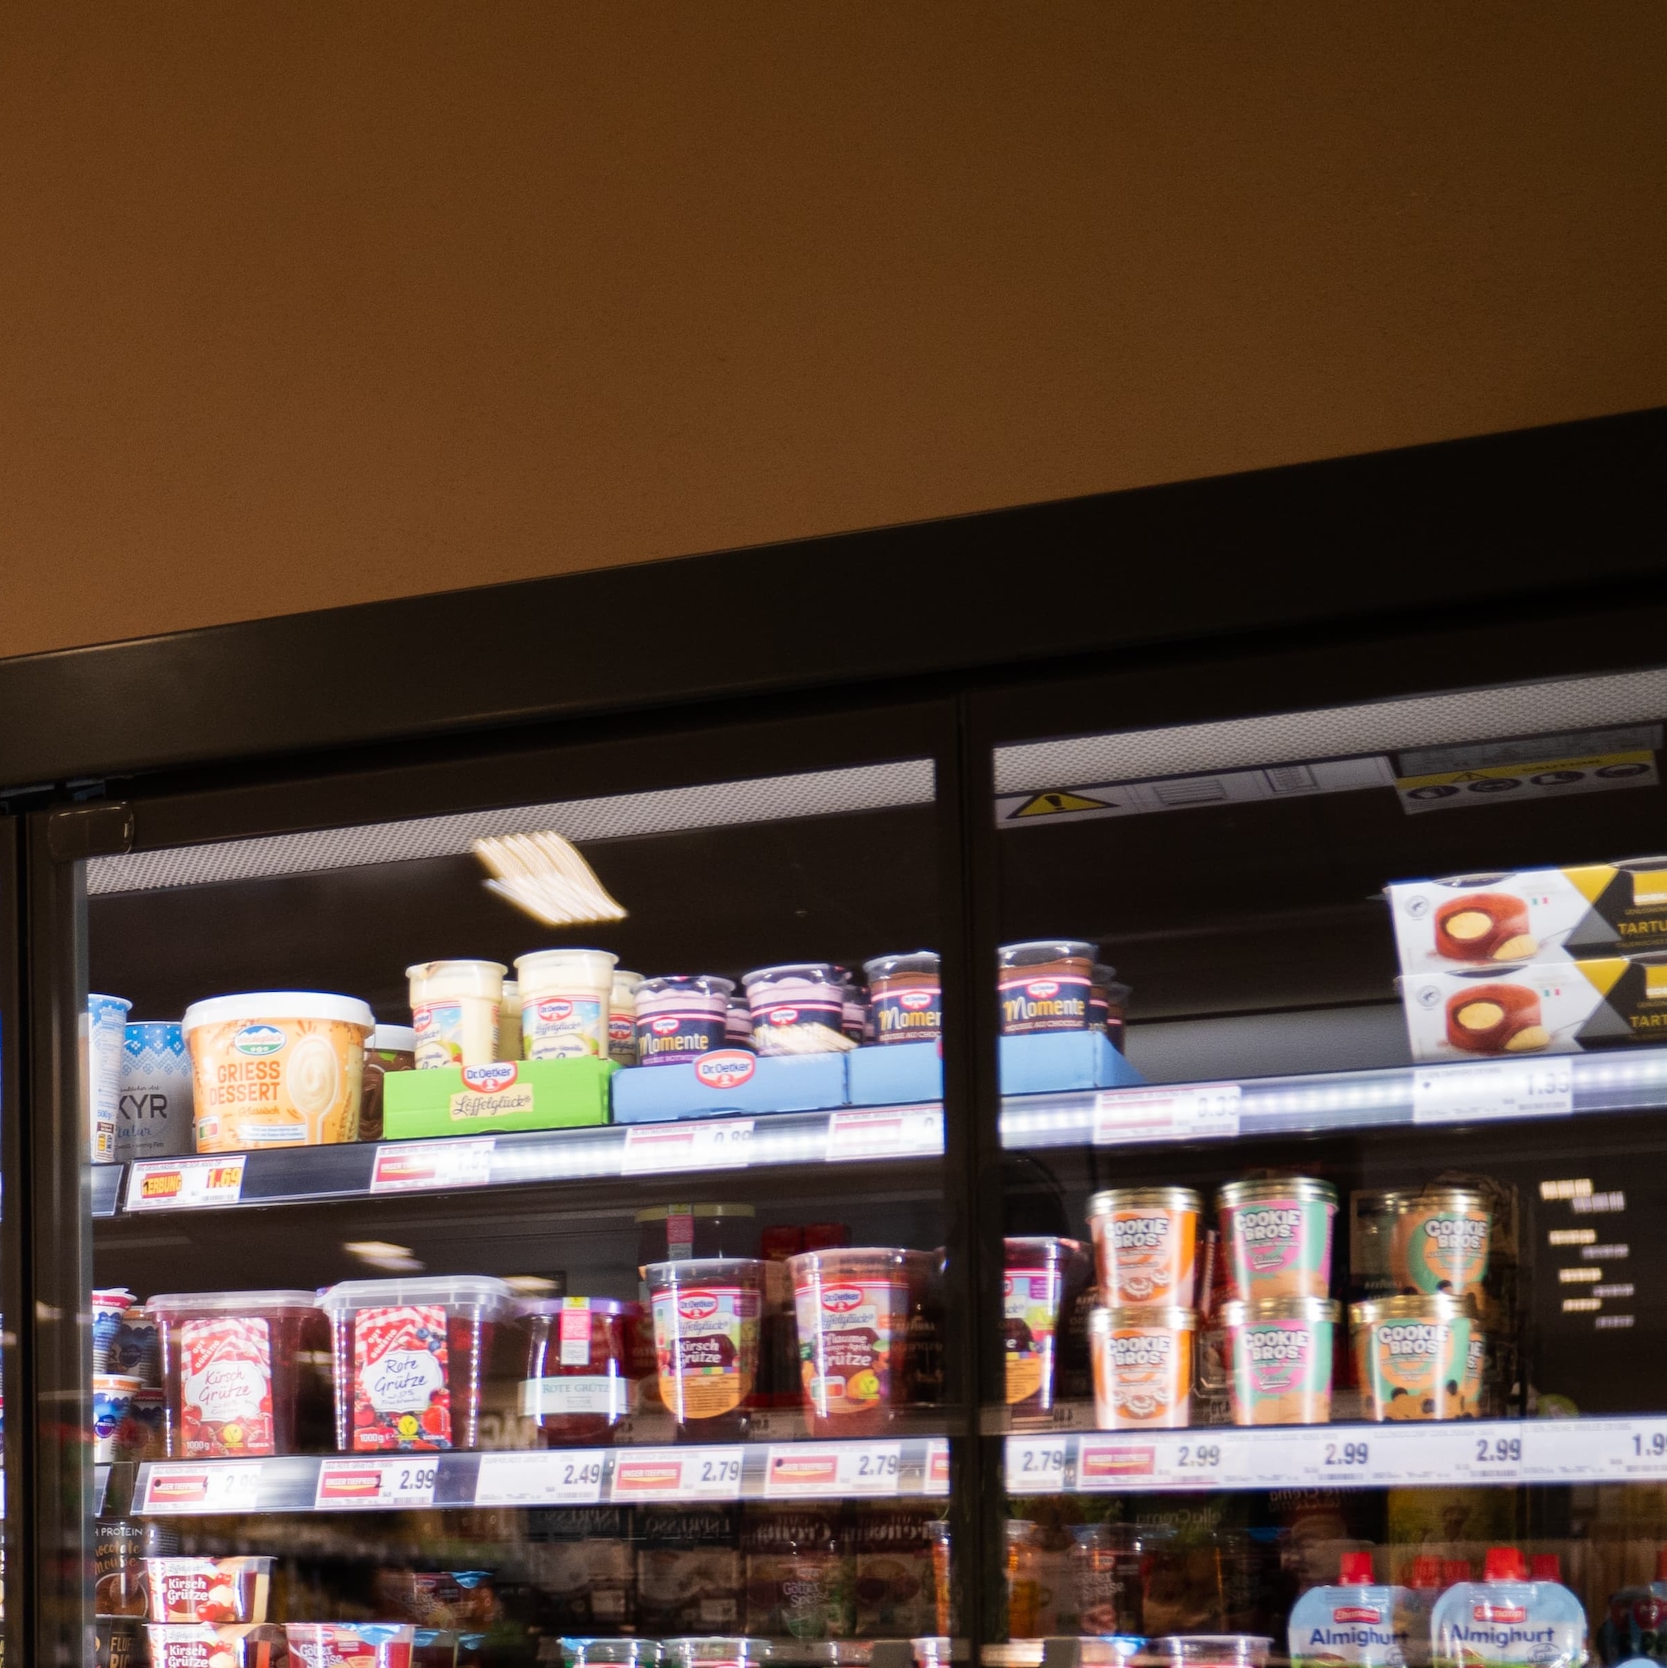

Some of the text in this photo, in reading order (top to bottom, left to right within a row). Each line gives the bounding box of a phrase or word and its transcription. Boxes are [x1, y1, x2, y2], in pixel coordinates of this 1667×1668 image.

[218, 1060, 280, 1082] GRIESS
[210, 1082, 281, 1106] DESSERT
[207, 1167, 242, 1188] 1.69
[1104, 1218, 1169, 1239] COOKIE
[1112, 1234, 1160, 1252] BROS.
[386, 1357, 418, 1375] Rote
[1022, 1450, 1063, 1473] 2.79
[1178, 1445, 1220, 1467] 2.99
[1325, 1442, 1368, 1466] 2.99
[1476, 1439, 1521, 1463] 2.99
[563, 1465, 600, 1486] 2.49
[703, 1461, 739, 1482] 2.79
[858, 1455, 897, 1476] 2.79
[399, 1470, 434, 1490] 2.99
[168, 1577, 206, 1590] Kirsch
[168, 1589, 208, 1605] Grütze
[169, 1643, 206, 1657] Kirsch
